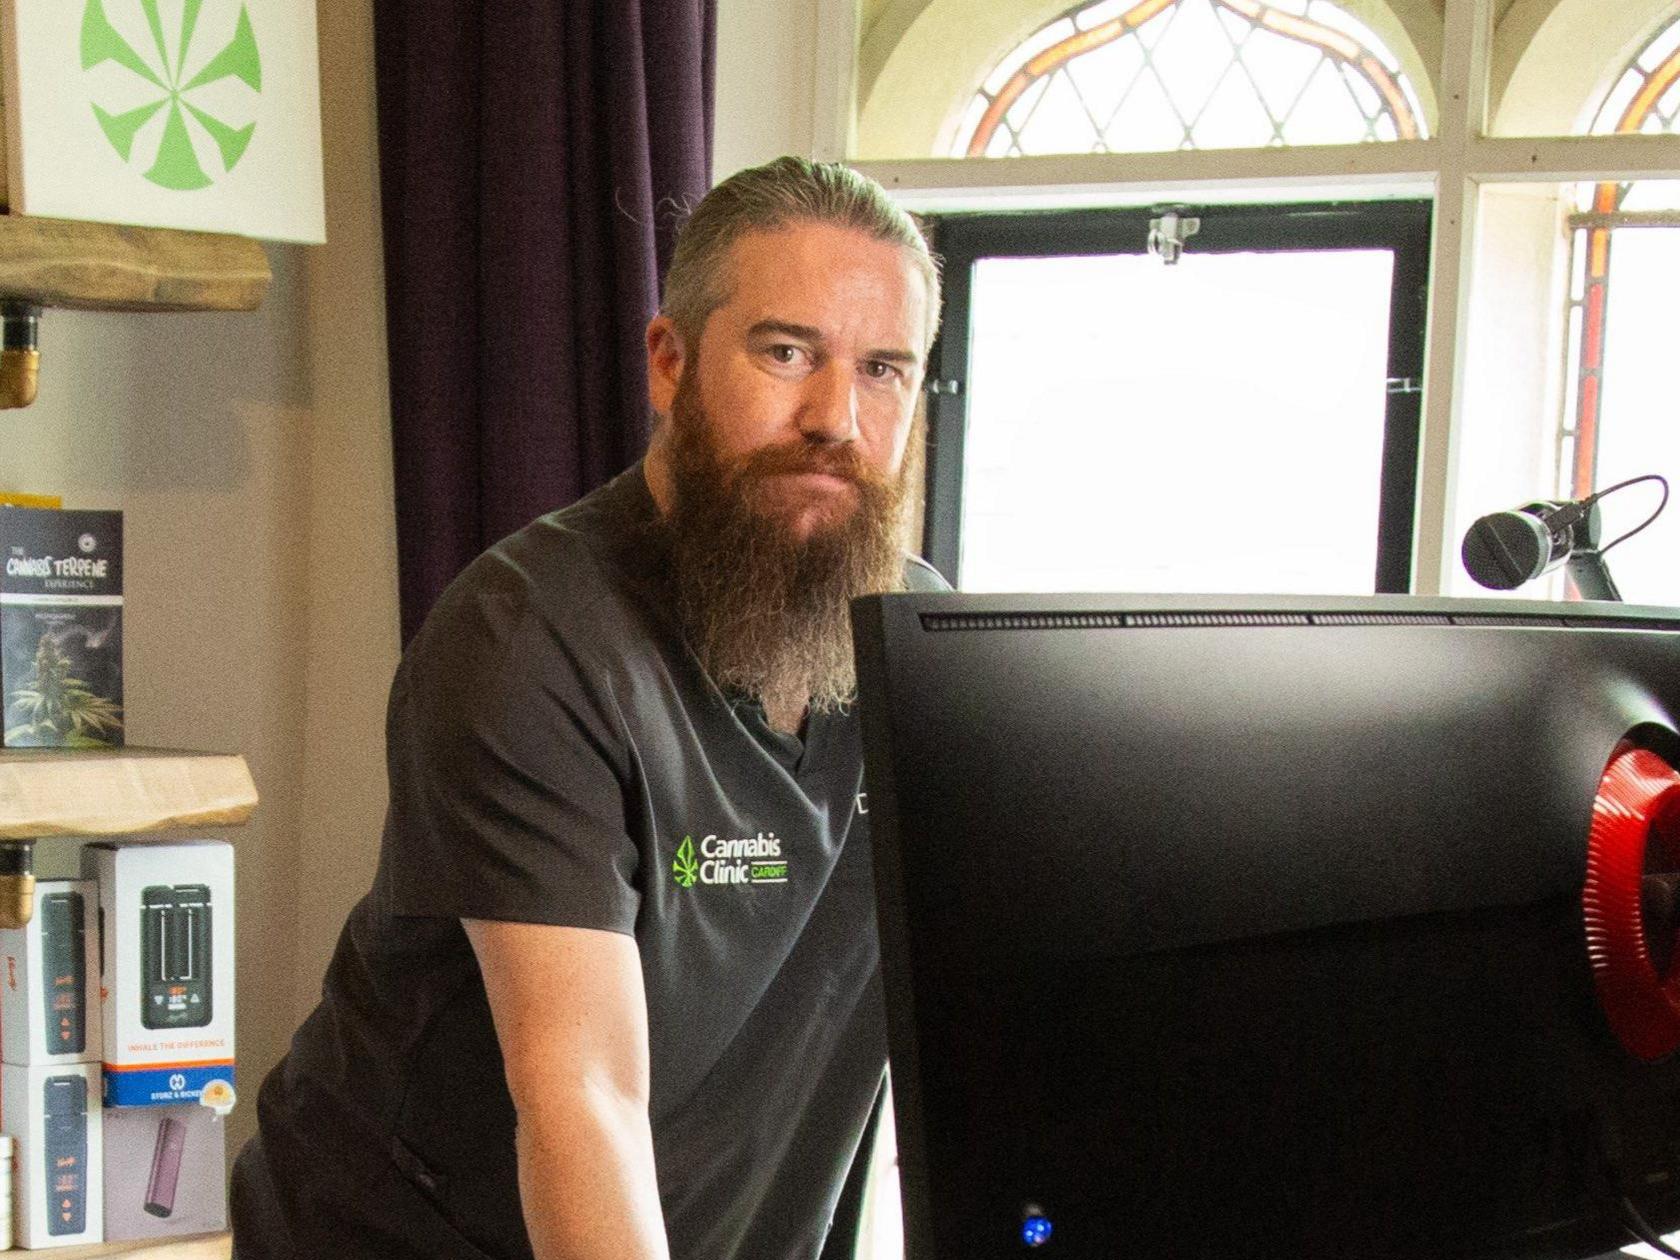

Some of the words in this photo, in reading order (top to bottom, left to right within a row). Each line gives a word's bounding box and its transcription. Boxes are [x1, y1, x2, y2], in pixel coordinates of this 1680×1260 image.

[53, 556, 108, 578] TERPENE
[701, 832, 781, 858] Cannabis
[699, 859, 749, 884] Clinic
[128, 1043, 158, 1052] INHALE
[160, 1042, 175, 1050] THE
[178, 1039, 225, 1049] DIFFERENCE
